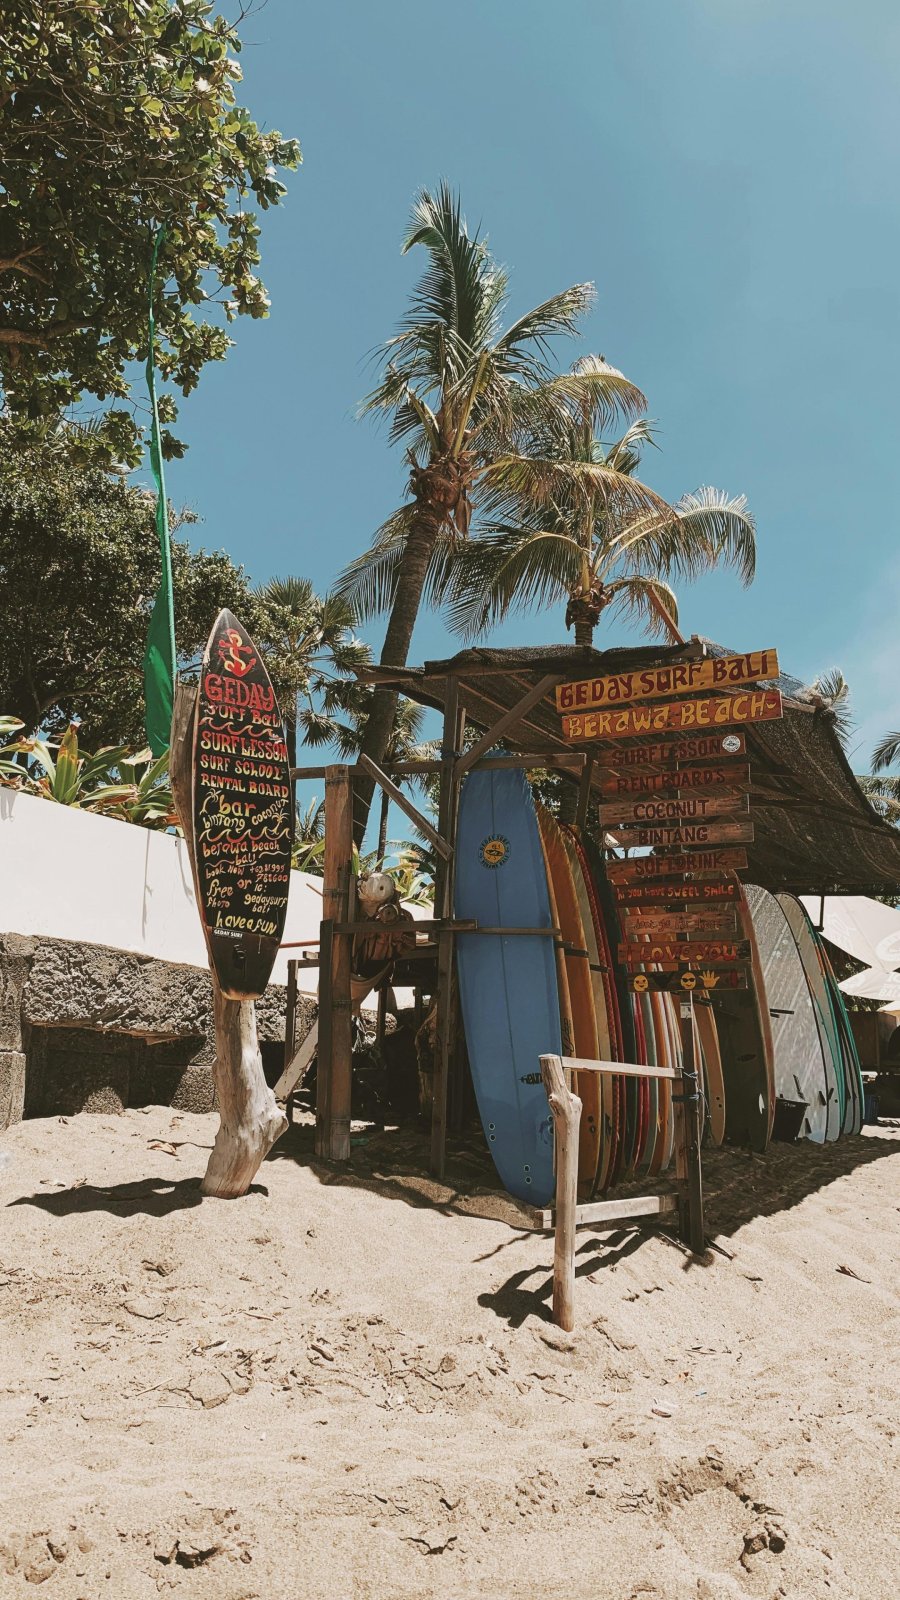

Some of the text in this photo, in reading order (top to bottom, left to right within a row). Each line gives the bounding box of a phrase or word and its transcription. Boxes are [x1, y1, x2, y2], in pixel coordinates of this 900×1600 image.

[204, 673, 275, 712] GEDAY
[200, 731, 287, 763] SURF LESSON
[611, 745, 657, 767] SURF
[200, 754, 231, 772] SURF
[200, 773, 289, 799] RENTAL BOARD
[616, 775, 659, 794] RENT
[219, 794, 257, 817] bar
[633, 799, 709, 820] COCONUT
[638, 826, 709, 845] BINTANG
[251, 839, 280, 853] beach
[205, 864, 227, 880] book
[206, 878, 234, 898] free
[236, 878, 252, 889] or
[215, 910, 246, 929] have
[640, 945, 690, 961] LOVE
[695, 943, 738, 961] YOU
